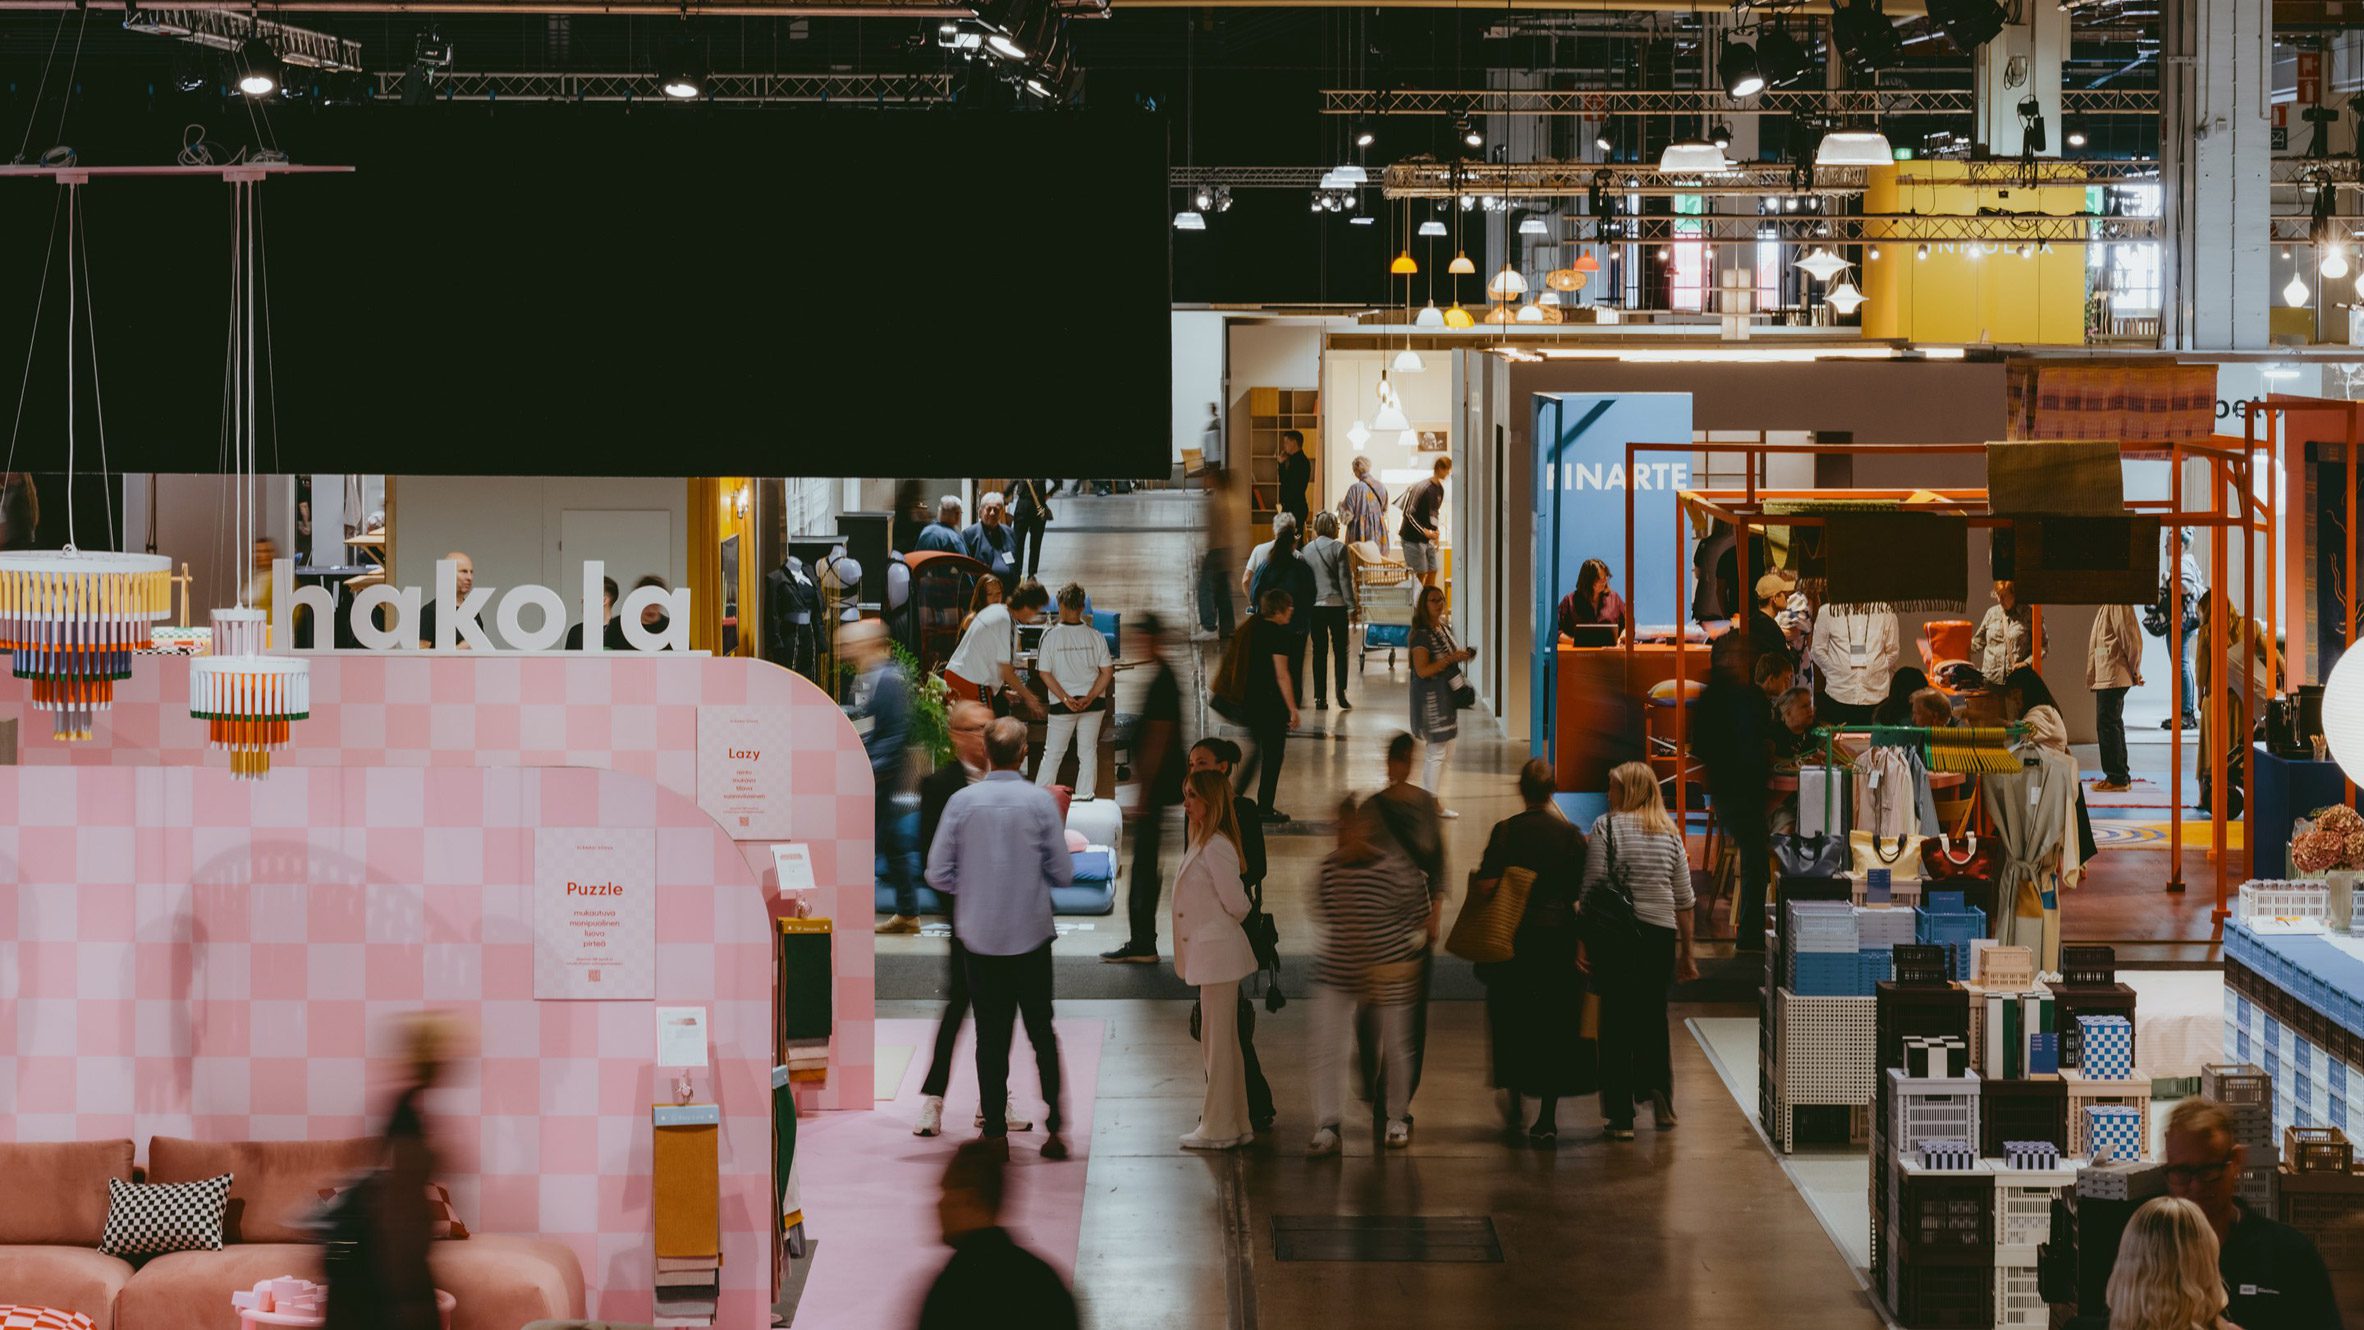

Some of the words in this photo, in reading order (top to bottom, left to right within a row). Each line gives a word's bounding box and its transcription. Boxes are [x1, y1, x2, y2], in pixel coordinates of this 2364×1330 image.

[272, 559, 691, 651] hakola
[728, 747, 761, 762] Lazy
[566, 881, 624, 896] Puzzle
[573, 909, 617, 917] mukautuva
[584, 929, 606, 938] luova
